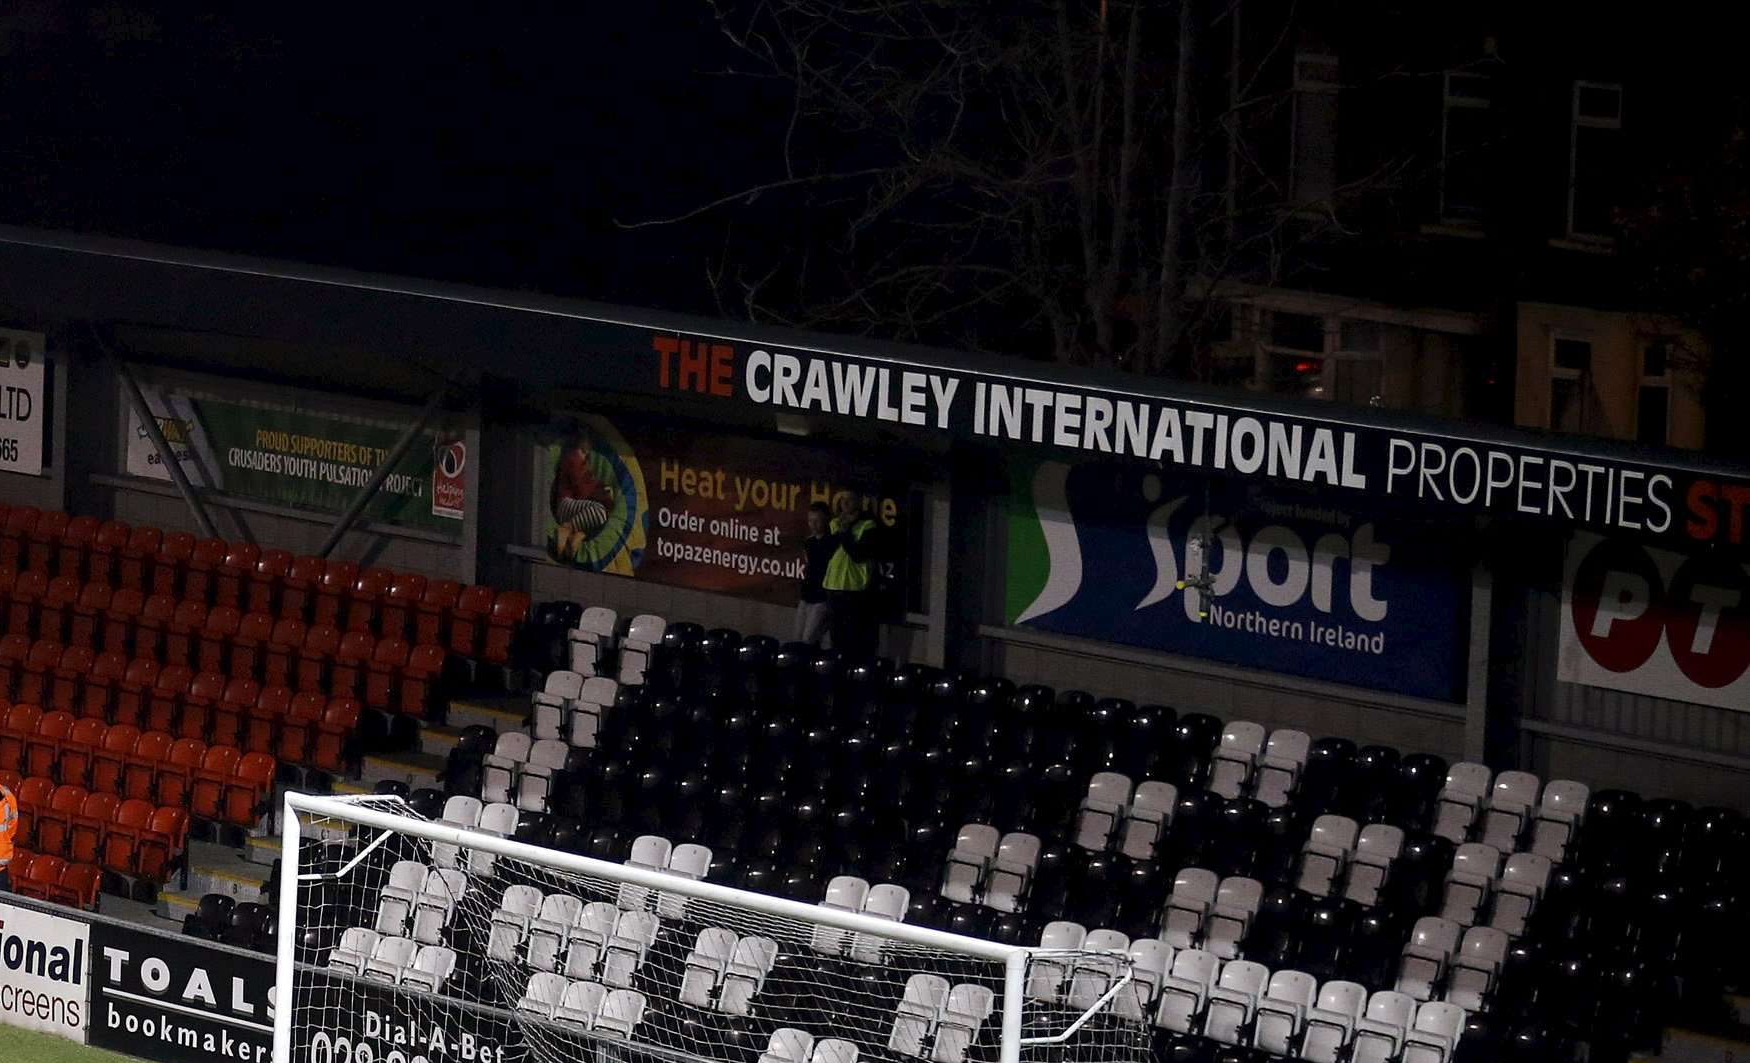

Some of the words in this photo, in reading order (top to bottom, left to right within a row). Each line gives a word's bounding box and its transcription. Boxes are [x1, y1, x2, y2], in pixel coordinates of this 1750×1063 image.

[256, 429, 290, 452] PROUD
[290, 434, 356, 465] SUPPORTERS
[359, 446, 372, 466] OF
[653, 336, 735, 397] THE
[745, 350, 960, 429] CRAWLEY
[973, 381, 1366, 490] INTERNATIONAL
[1386, 438, 1673, 533] PROPERTIES
[1685, 478, 1750, 545] ST
[228, 447, 282, 474] CRUSADERS
[283, 455, 317, 480] YOUTH
[319, 461, 373, 487] PULSATIO
[378, 472, 424, 497] ROJECT
[659, 457, 727, 500] Heat
[734, 475, 802, 513] your
[658, 506, 705, 533] Order
[709, 516, 760, 543] online
[764, 526, 781, 546] at
[656, 536, 807, 581] topazenergy.co.uk
[1209, 603, 1304, 641] Northern
[1309, 617, 1386, 655] Ireland
